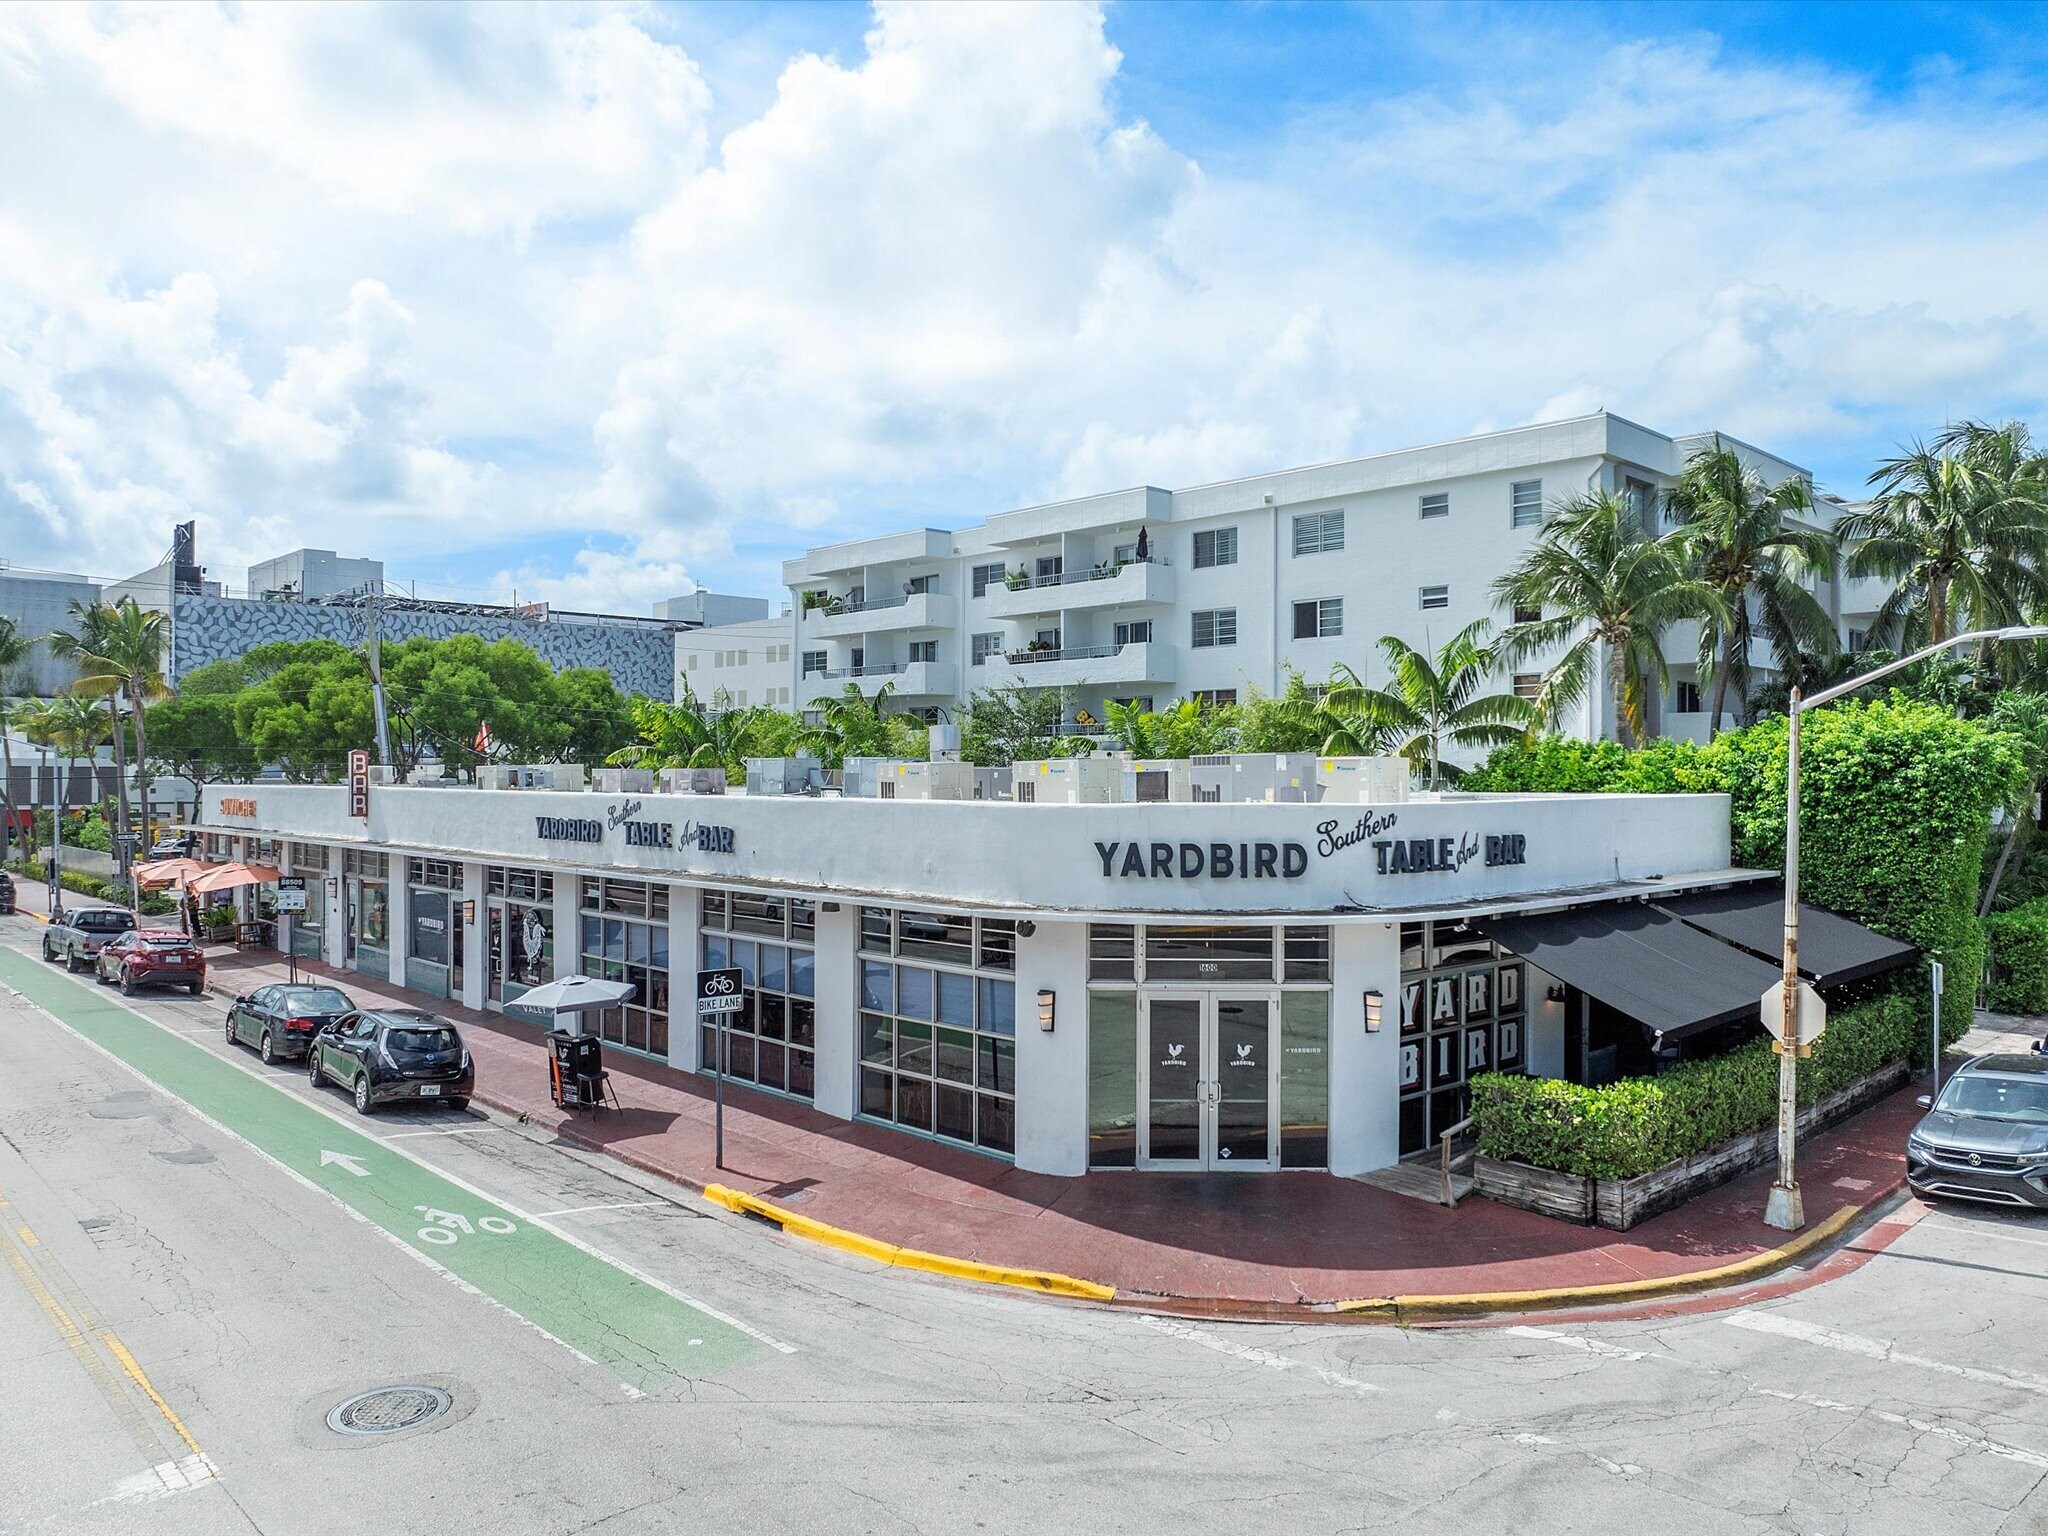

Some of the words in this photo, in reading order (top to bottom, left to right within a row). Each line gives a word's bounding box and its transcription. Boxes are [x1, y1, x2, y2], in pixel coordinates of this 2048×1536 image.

[353, 754, 367, 815] BAR
[220, 797, 257, 817] SUVICHE
[607, 799, 642, 831] Southern
[536, 817, 602, 843] YARDBIRD
[623, 821, 673, 848] TABLE
[678, 819, 700, 853] And
[698, 825, 735, 853] BAR
[1094, 842, 1308, 879] YARDBIRD
[1316, 809, 1398, 858] Southern
[1372, 838, 1455, 875] TABLE
[1454, 831, 1480, 873] And
[1485, 834, 1526, 867] BAR
[1199, 963, 1218, 972] 1600
[522, 1004, 547, 1015] VALET
[699, 1000, 717, 1011] BIKE
[719, 997, 740, 1009] LANE
[1400, 968, 1518, 1027] YARD
[1400, 1022, 1518, 1086] BIRD
